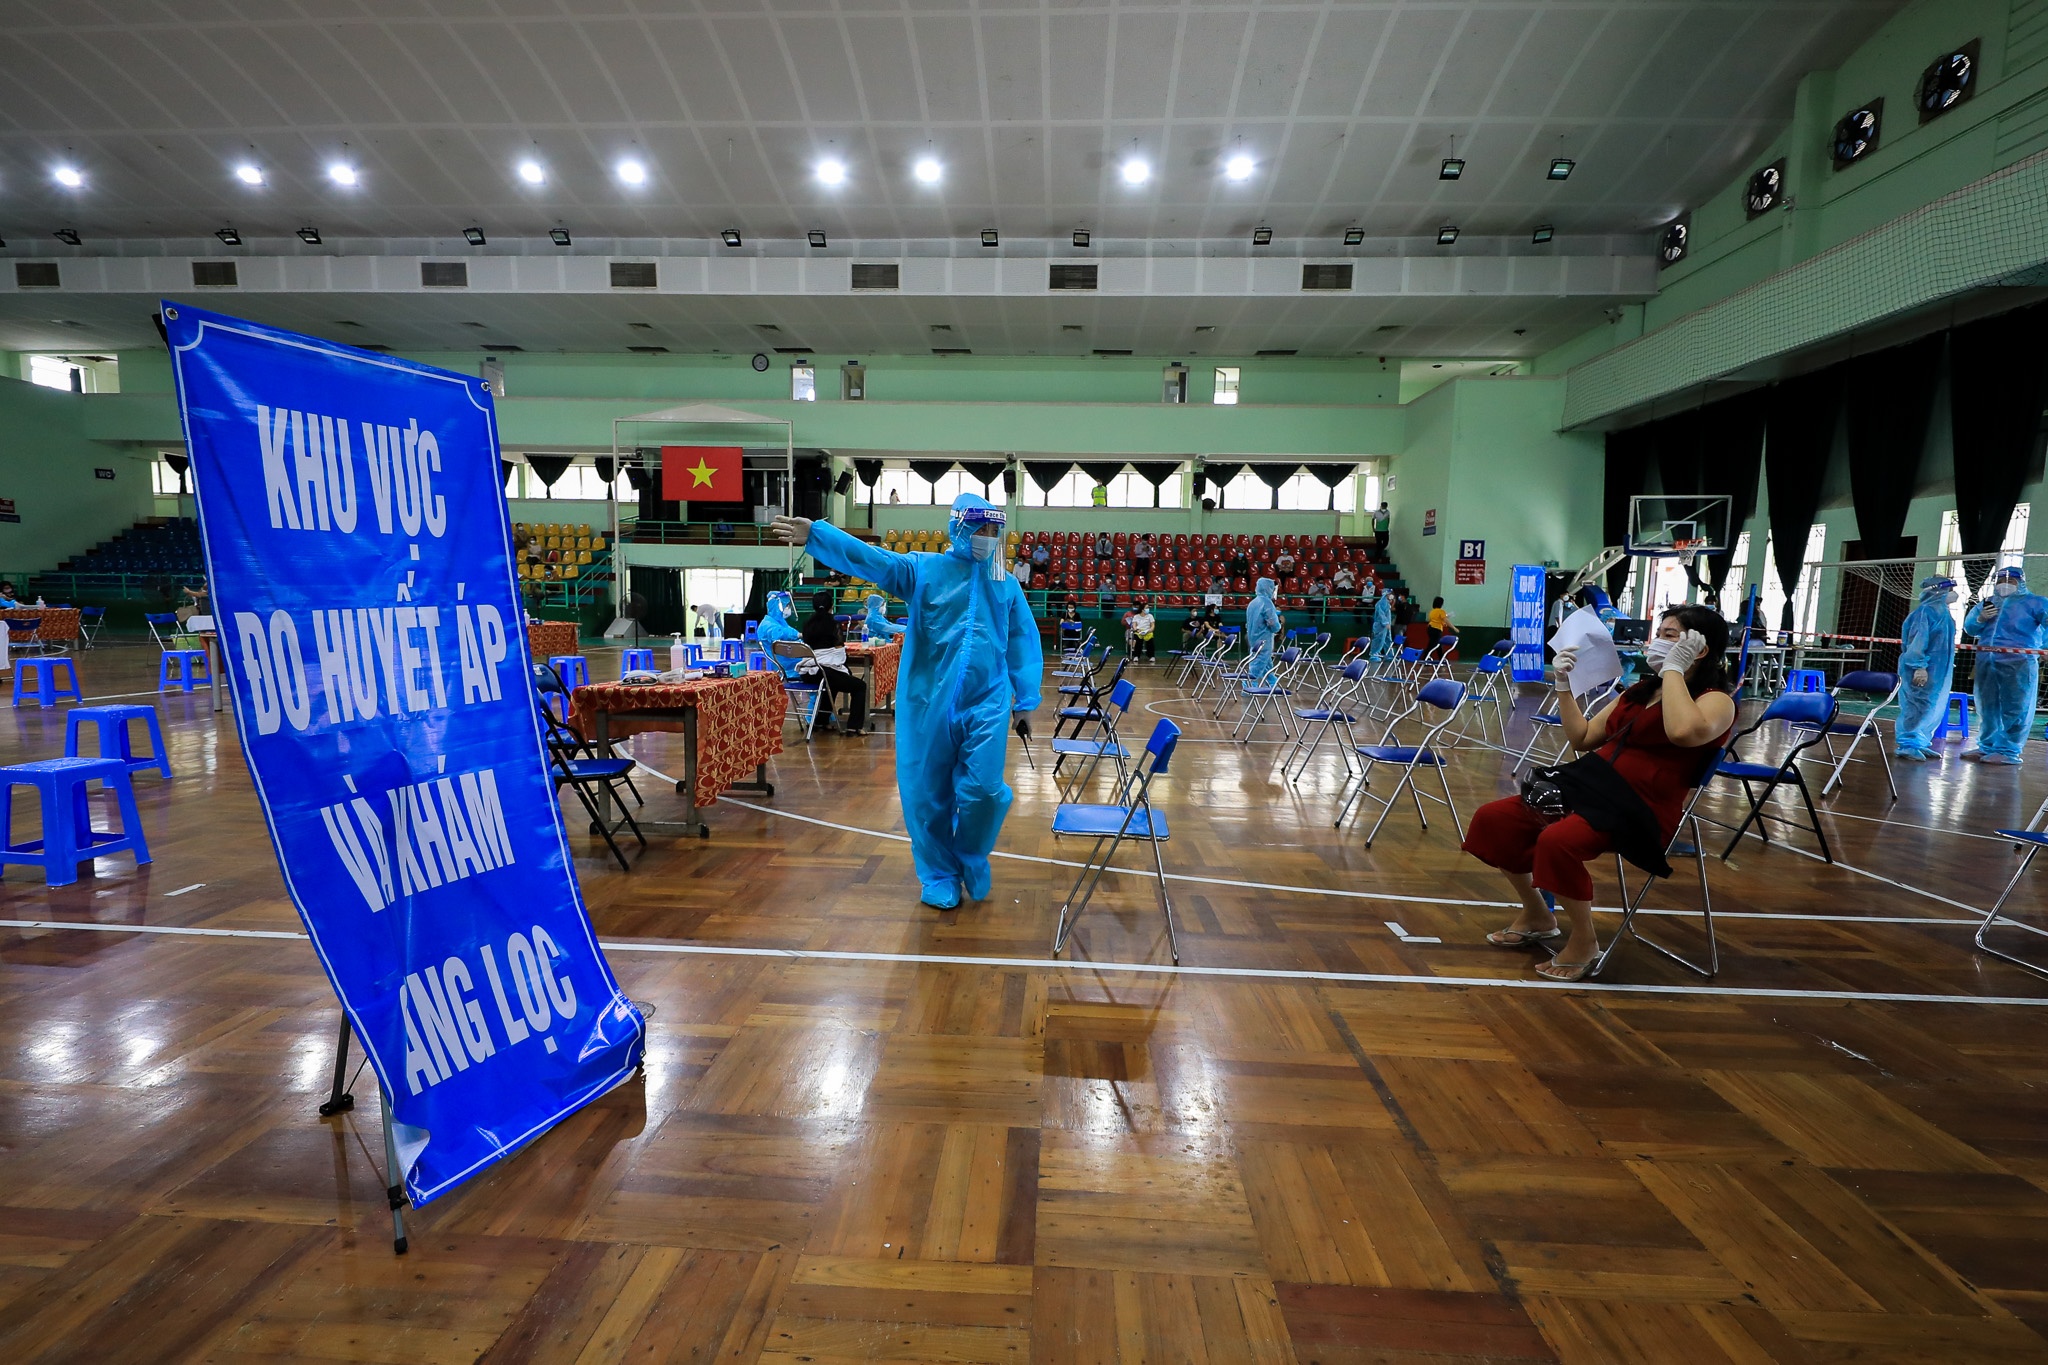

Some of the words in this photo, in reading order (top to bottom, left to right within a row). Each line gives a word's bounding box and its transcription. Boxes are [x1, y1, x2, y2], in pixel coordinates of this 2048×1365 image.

[257, 405, 357, 533] KHU
[361, 417, 447, 560] VỰC
[1463, 542, 1482, 558] B1
[234, 609, 310, 736] ĐO
[313, 570, 446, 726] HUYẾT
[455, 582, 507, 705] ÁP
[386, 755, 516, 898] KHÁM
[400, 956, 497, 1097] ANG
[484, 925, 578, 1055] LỌC
